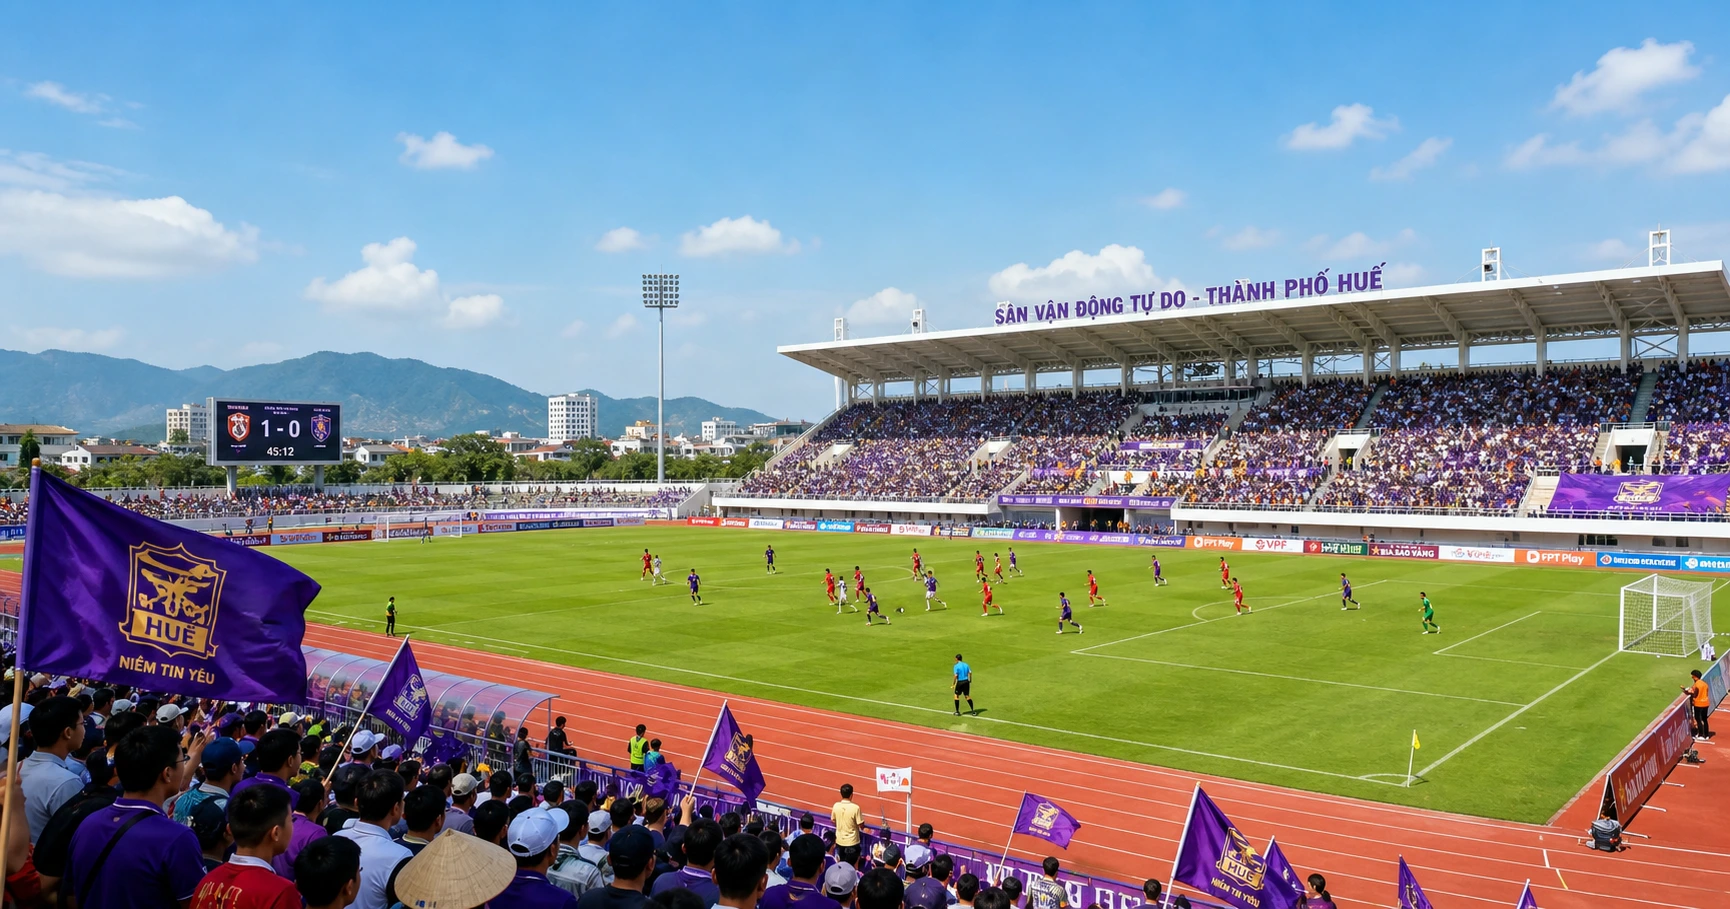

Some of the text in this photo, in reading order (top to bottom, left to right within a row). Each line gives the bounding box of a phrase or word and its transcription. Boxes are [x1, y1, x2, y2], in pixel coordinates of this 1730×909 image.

[995, 303, 1028, 325] SÂN
[1034, 299, 1069, 324] VẬN
[1075, 295, 1124, 320] ĐỘNG
[1130, 291, 1155, 316] TỰ
[1161, 290, 1186, 309] DO
[1205, 280, 1276, 305] THÀNH
[1285, 268, 1331, 298] PHỐ
[1338, 262, 1387, 292] HUẾ
[261, 419, 269, 437] 1
[289, 420, 300, 438] 0
[266, 446, 295, 457] 45:12
[1266, 540, 1288, 550] VPF
[1541, 553, 1585, 566] FPT Play
[160, 663, 185, 680] TIN
